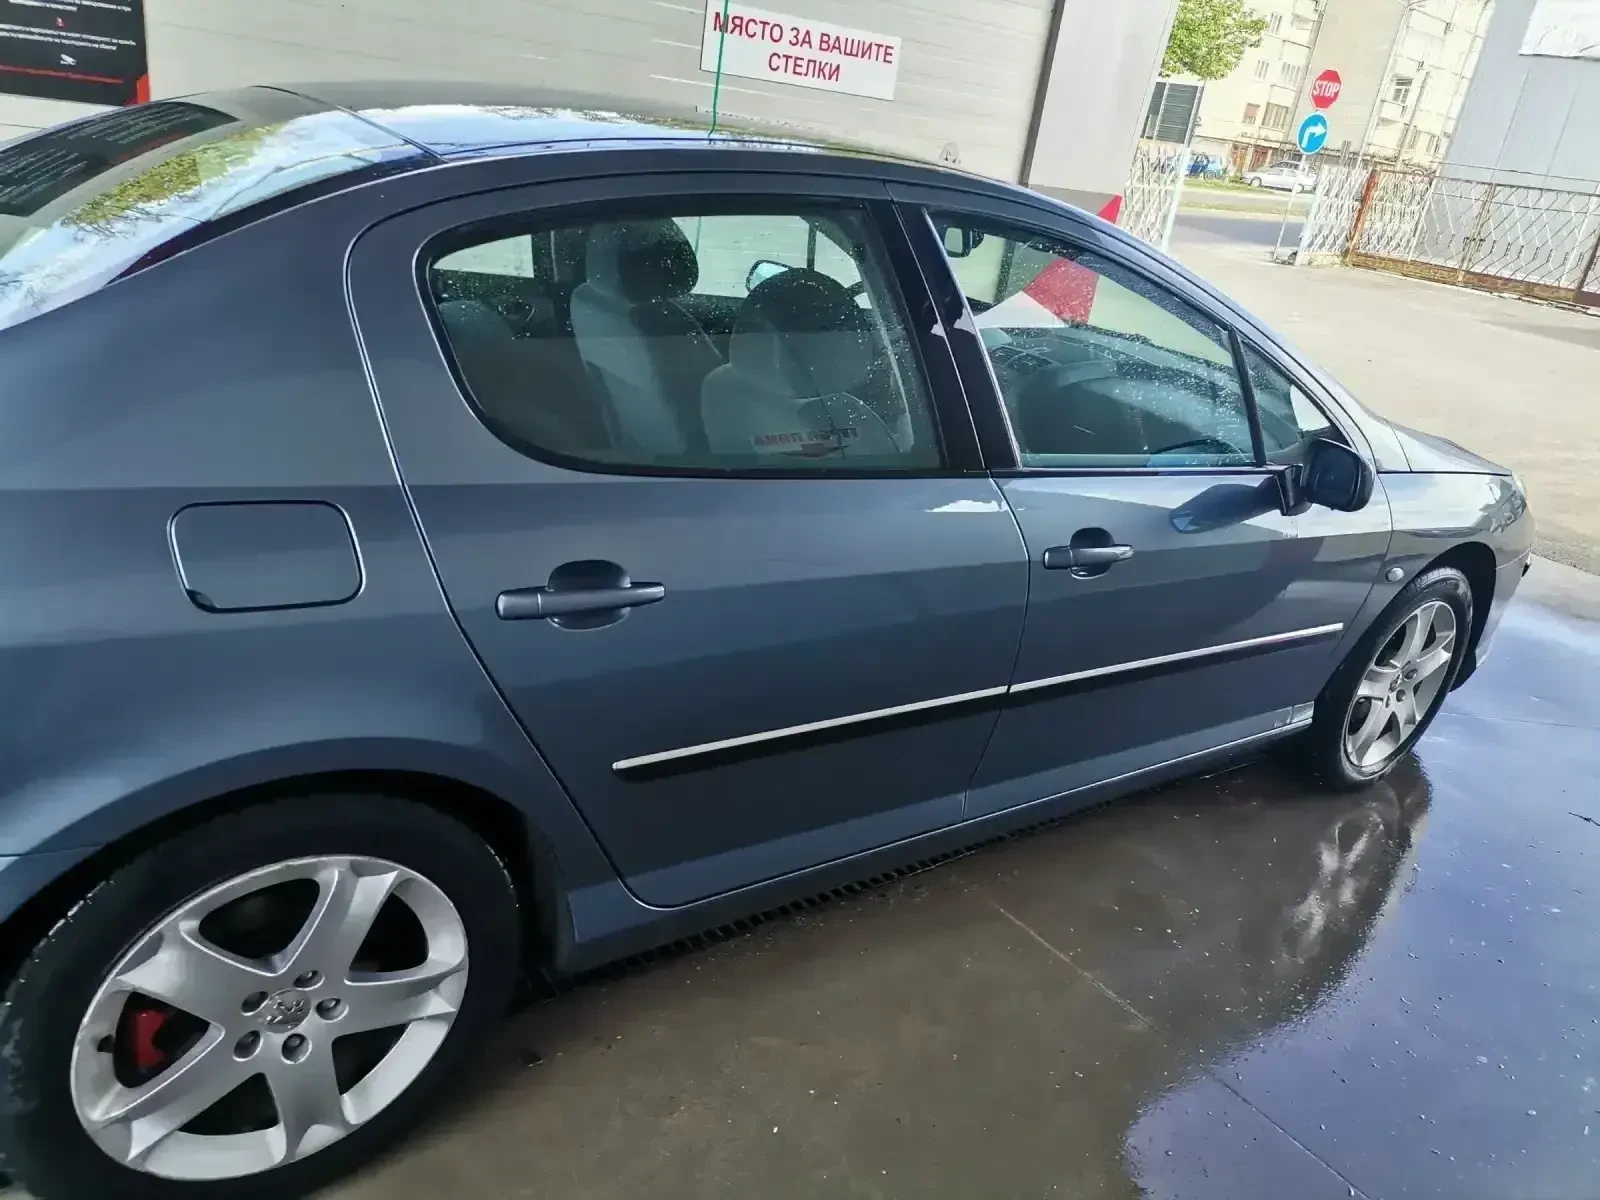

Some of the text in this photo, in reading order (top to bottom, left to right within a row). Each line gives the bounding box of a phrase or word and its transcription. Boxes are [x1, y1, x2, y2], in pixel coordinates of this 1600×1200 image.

[713, 11, 895, 64] МЯСТО ЗА ВАШИТЕ
[768, 52, 841, 82] СТЕЛКИ
[1313, 80, 1340, 97] STOP
